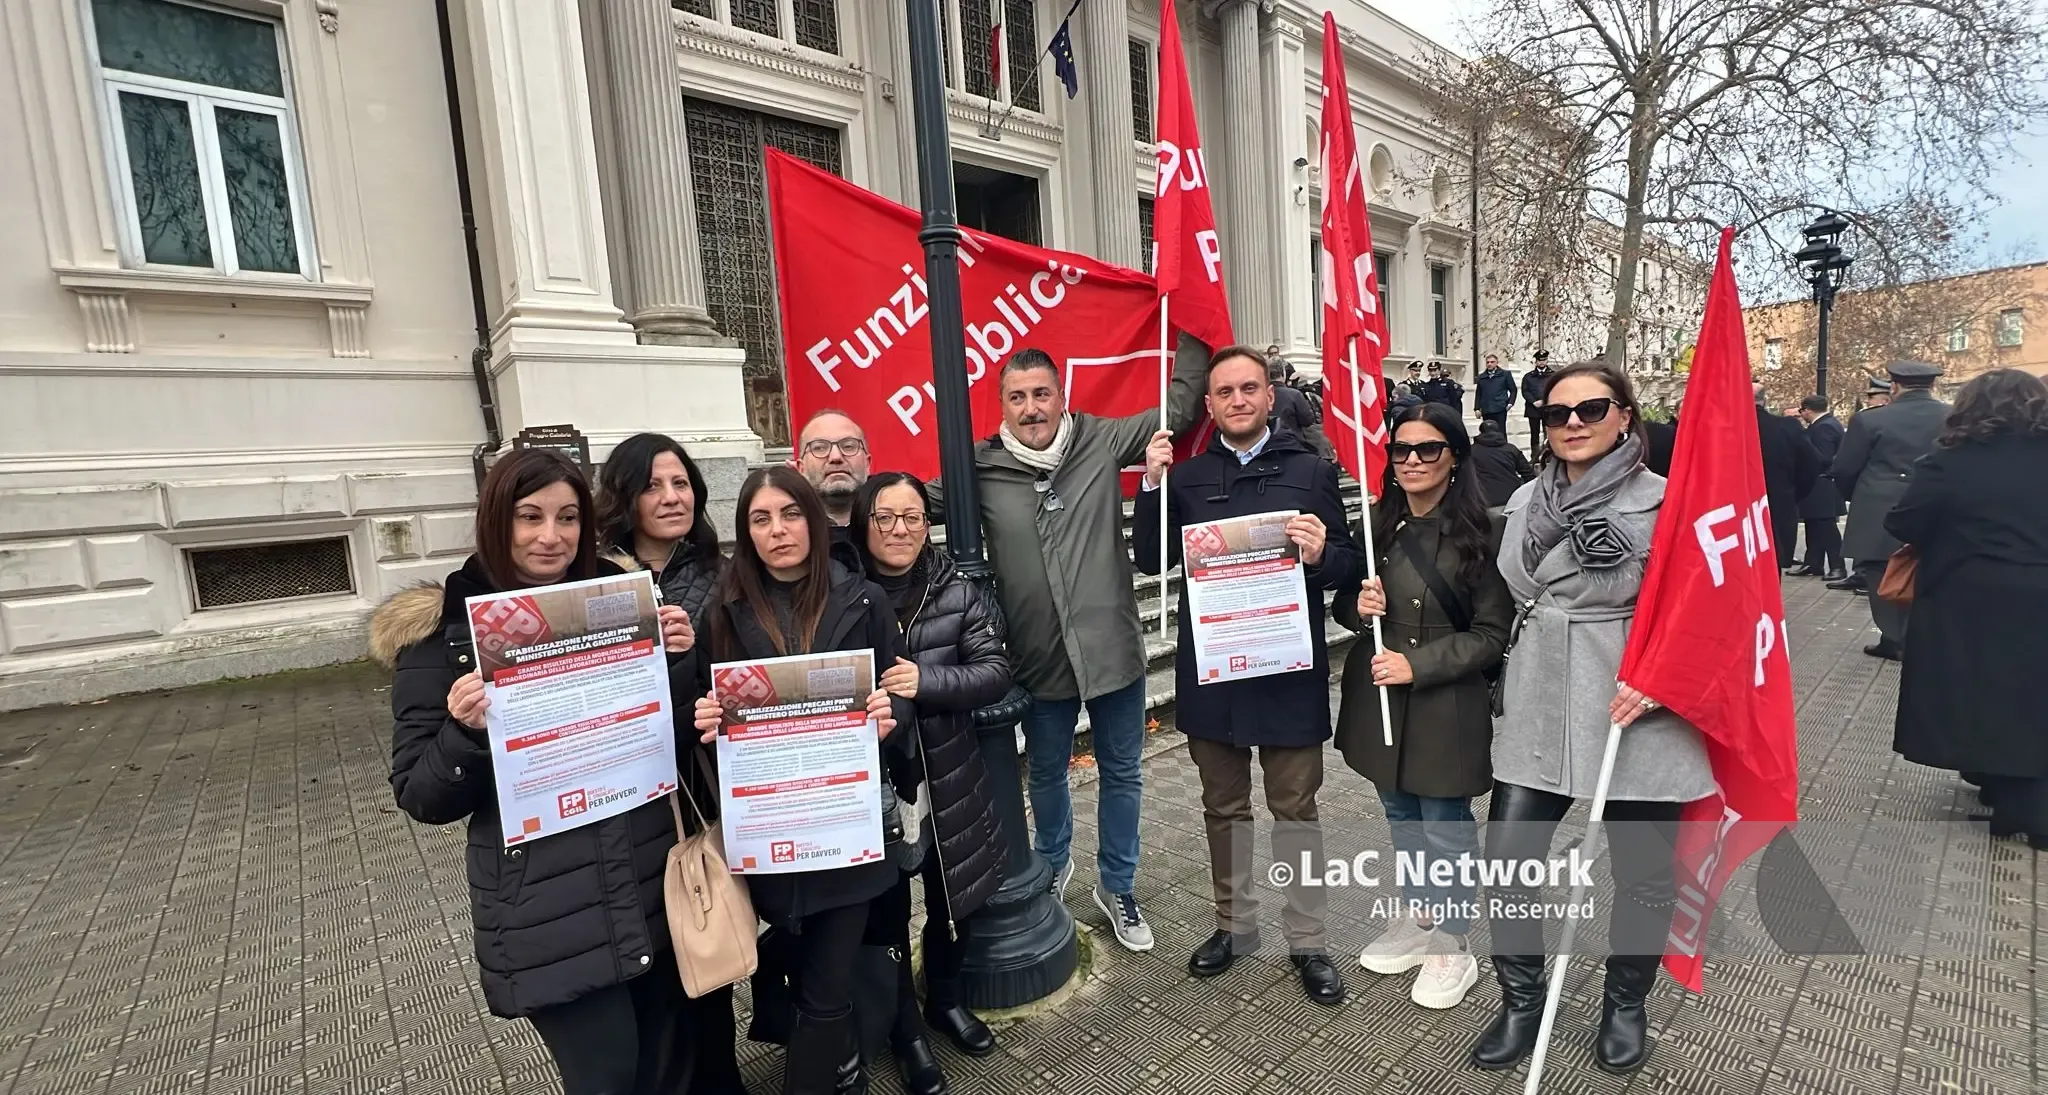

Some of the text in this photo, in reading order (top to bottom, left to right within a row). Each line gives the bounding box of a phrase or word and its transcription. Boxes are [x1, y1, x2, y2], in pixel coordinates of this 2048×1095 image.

[505, 626, 639, 658] STABILIZZAZIONE PRECARI PNRR
[516, 634, 632, 663] MINISTERO DELLA GIUSTIZIA
[499, 669, 547, 684] STRAORDINARIA
[548, 666, 566, 675] DELLE
[566, 659, 602, 671] LAVORATRICI
[617, 648, 650, 659] LAVORATORI
[517, 645, 633, 675] GRANDE RISULTATO DELLA MOBILITAZIONE
[738, 703, 801, 716] STABILIZZAZIONE
[803, 700, 833, 709] PRECARI
[746, 705, 847, 721] MINISTERO DELLA GIUSTIZIA
[561, 792, 583, 809] FP
[589, 786, 637, 809] PER DAVVERO
[564, 806, 584, 817] CGIL
[774, 843, 792, 856] FP
[796, 848, 841, 860] PER DAVVERO
